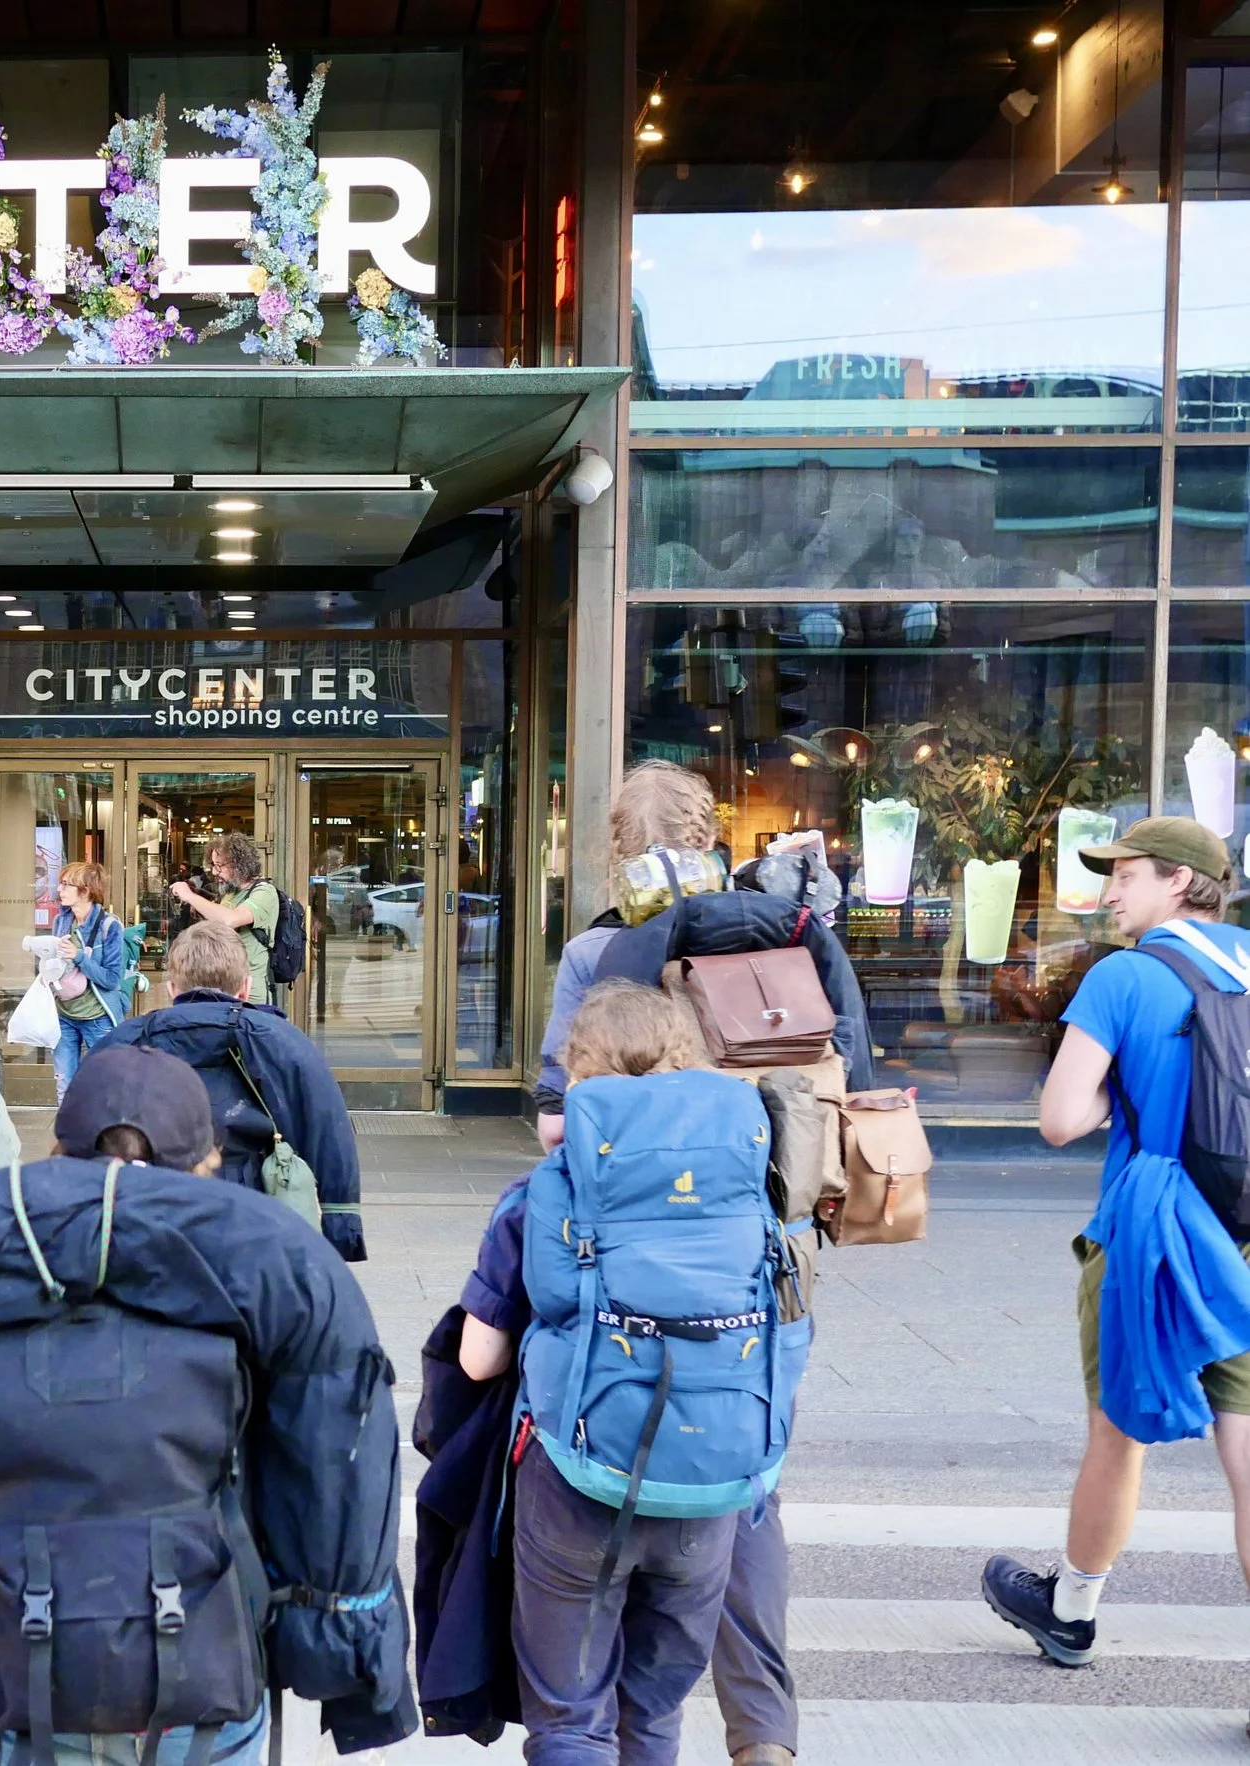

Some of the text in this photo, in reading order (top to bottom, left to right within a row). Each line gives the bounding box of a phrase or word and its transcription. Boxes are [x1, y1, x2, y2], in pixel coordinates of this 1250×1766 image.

[797, 352, 901, 379] FRESH
[25, 668, 377, 702] CITYCENTER
[154, 704, 380, 729] shopping centre
